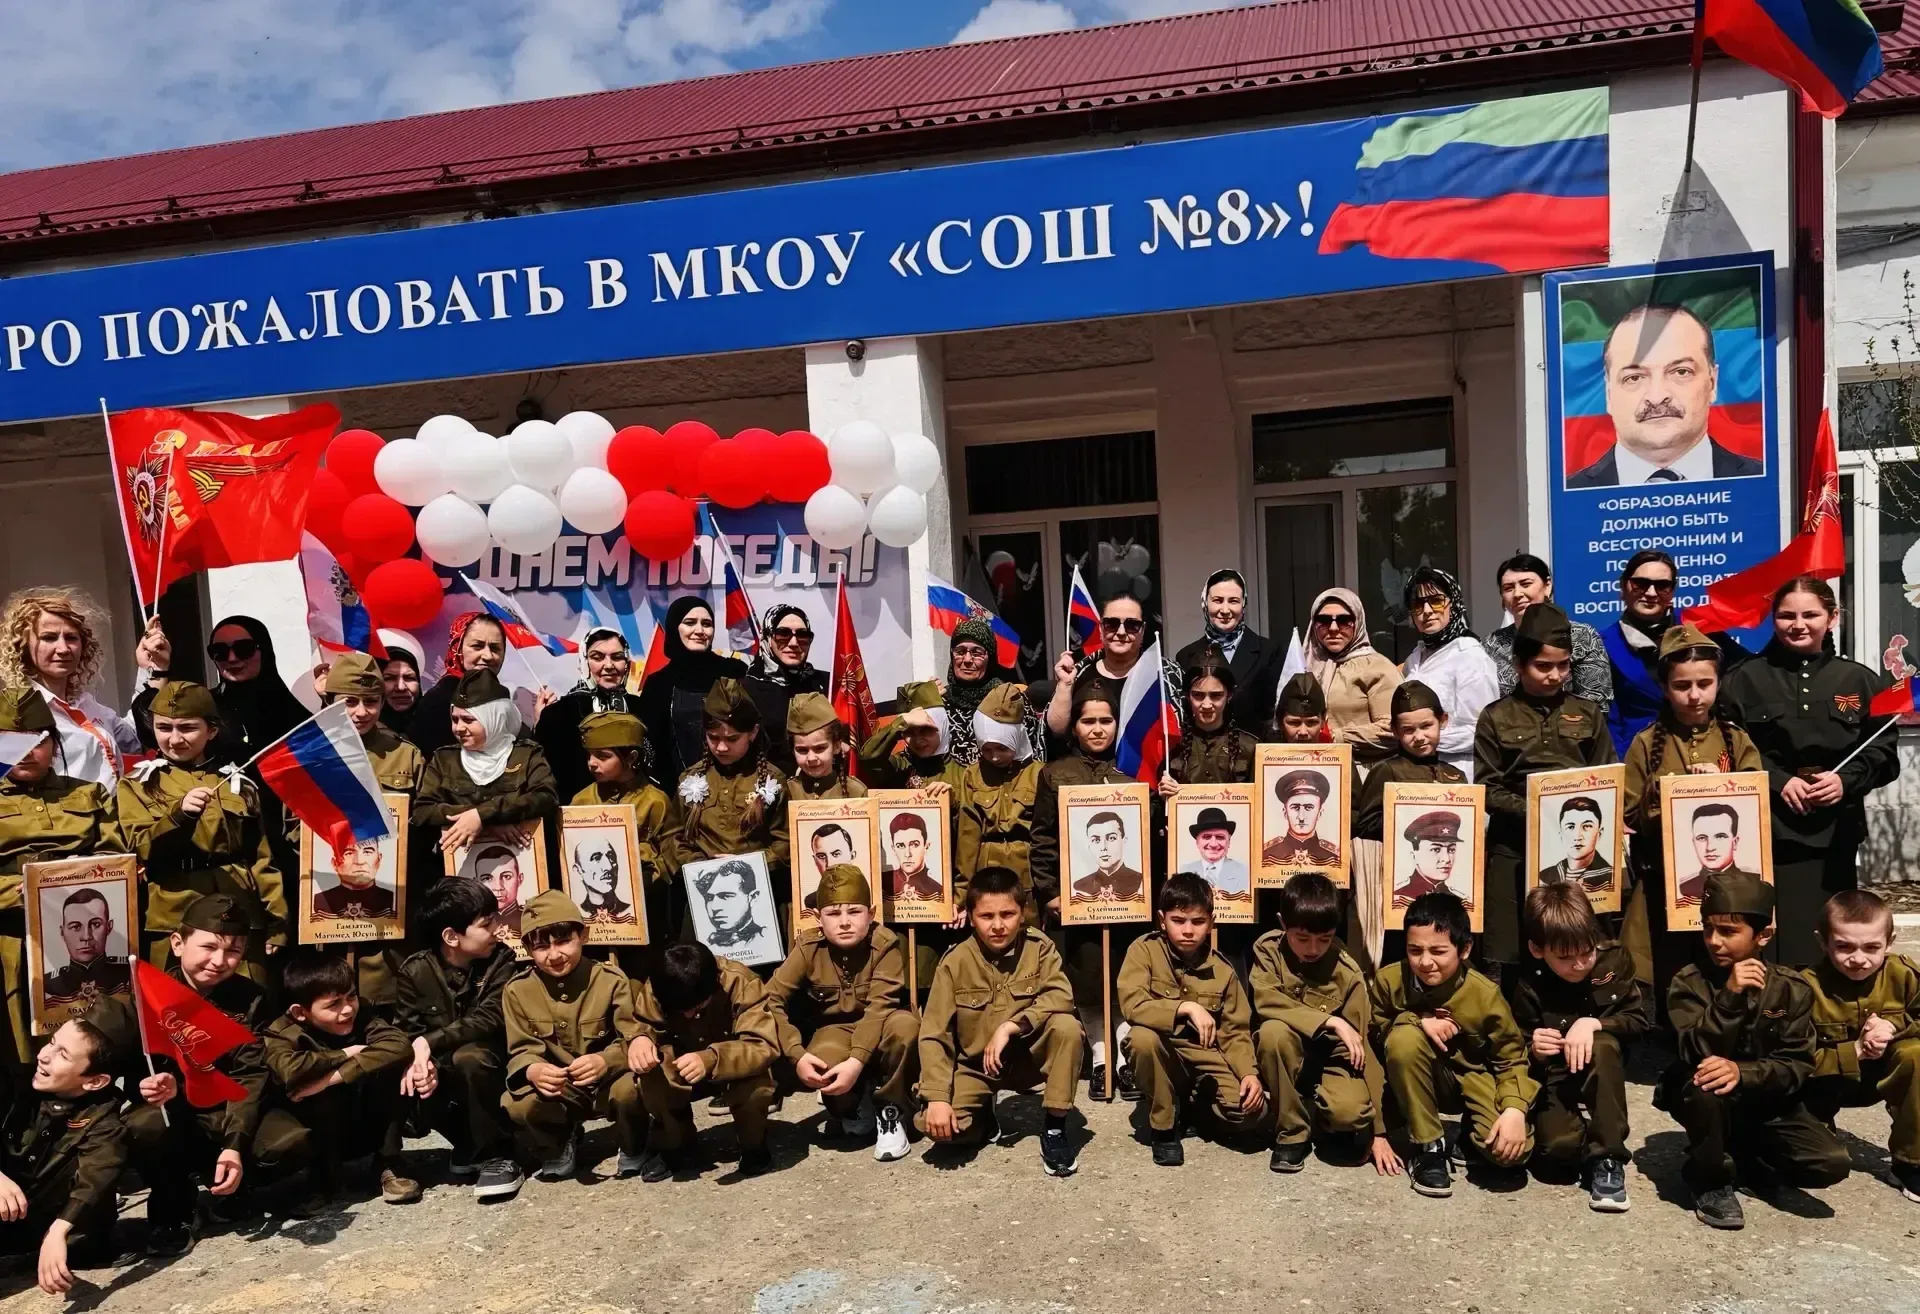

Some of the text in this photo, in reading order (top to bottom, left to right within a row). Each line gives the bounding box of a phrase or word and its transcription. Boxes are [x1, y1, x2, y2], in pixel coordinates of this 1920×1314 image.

[0, 319, 82, 372] РО
[98, 266, 564, 362] ПОЖАЛОВАТЬ
[584, 258, 627, 309] В
[650, 230, 864, 303] МКОУ
[889, 204, 1115, 277] «СОШ
[1598, 490, 1732, 511] «ОБРАЗОВАНИЕ
[1601, 512, 1729, 533] ДОЛЖНО БЫТЬ
[1588, 532, 1743, 553] ВСЕСТОРОННИМ И
